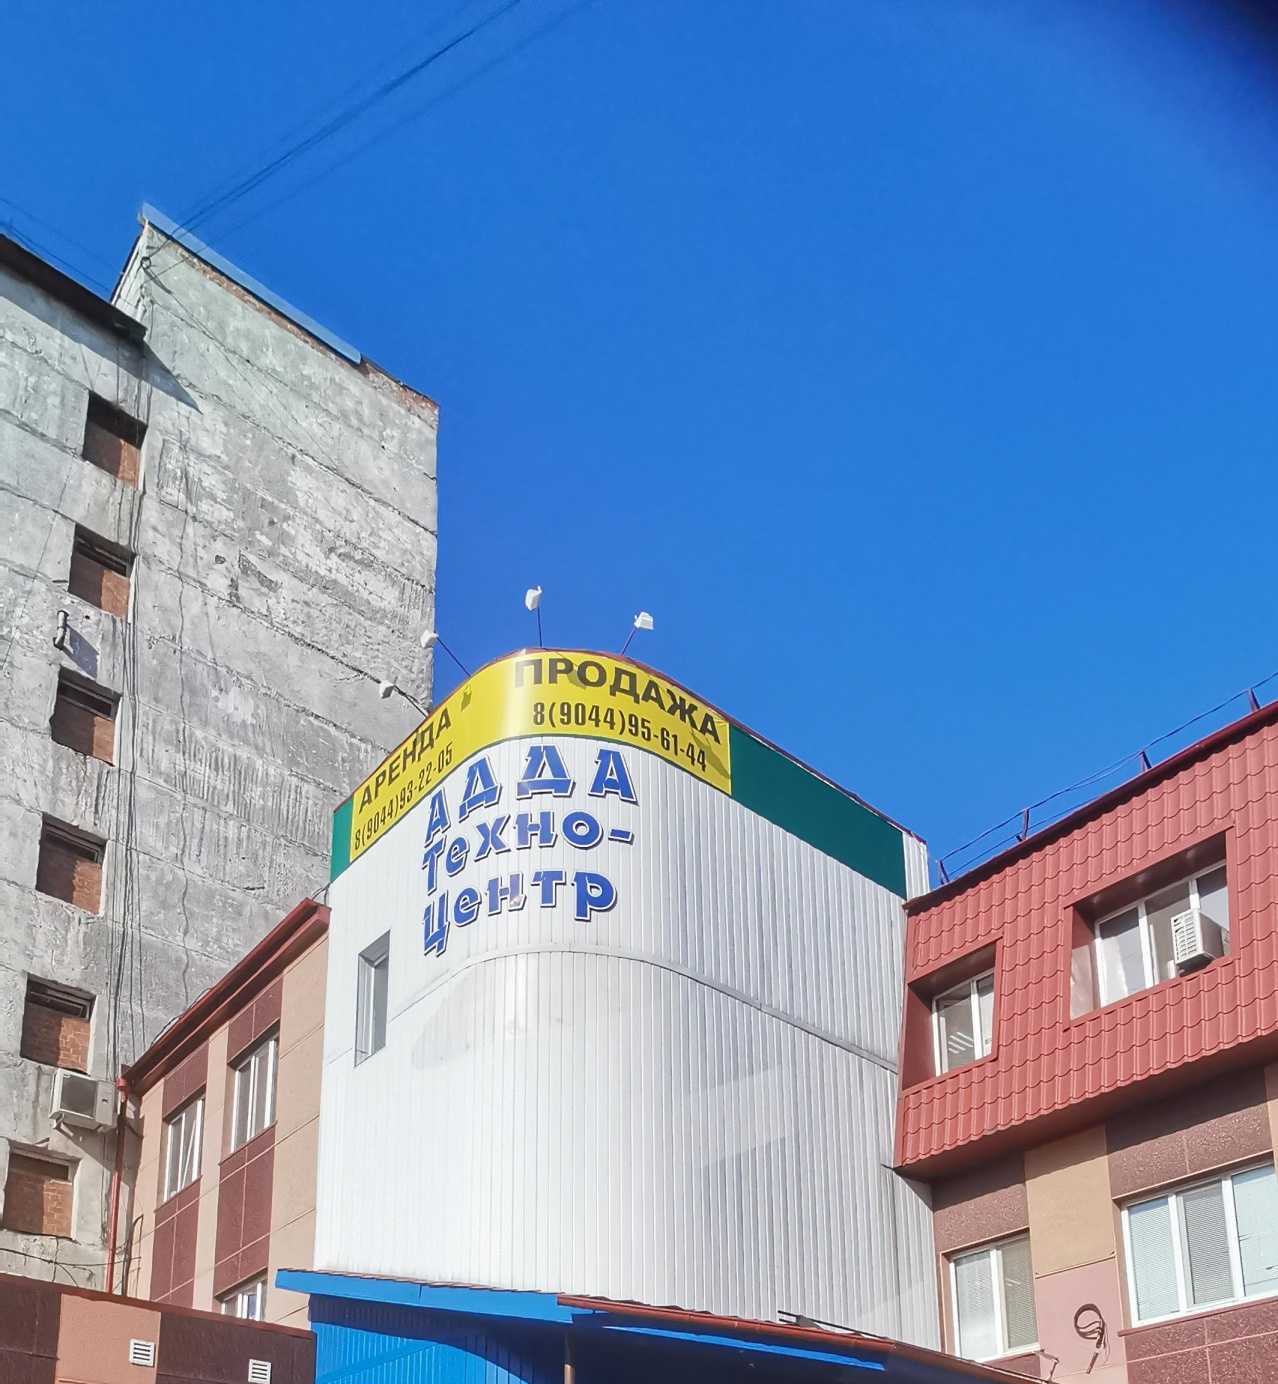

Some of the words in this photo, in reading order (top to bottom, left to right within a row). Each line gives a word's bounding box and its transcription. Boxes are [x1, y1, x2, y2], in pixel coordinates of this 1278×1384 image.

[515, 658, 721, 744] ПРОДАЖА
[533, 702, 707, 772] 8(9044)95-61-44
[354, 742, 453, 851] 8(9044)93-22-05
[359, 708, 452, 814] АРЕНДА
[425, 745, 639, 844] АДДА
